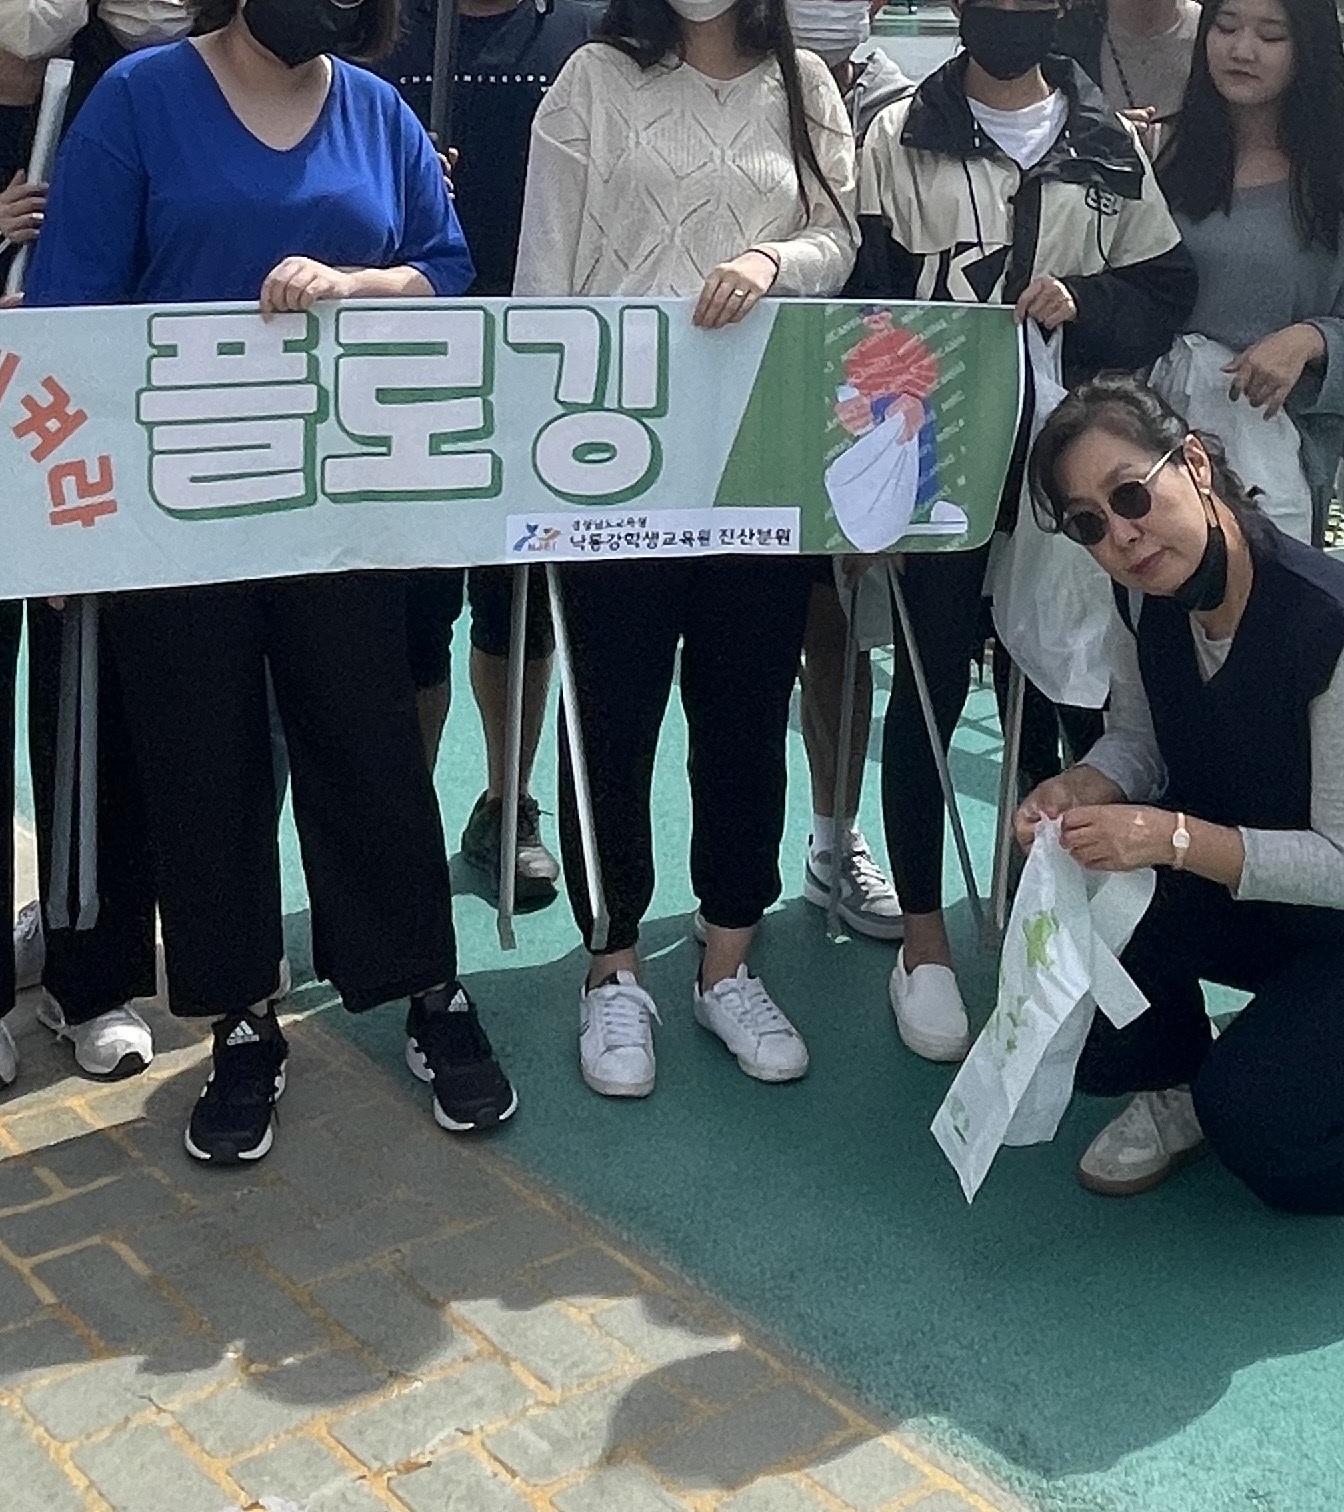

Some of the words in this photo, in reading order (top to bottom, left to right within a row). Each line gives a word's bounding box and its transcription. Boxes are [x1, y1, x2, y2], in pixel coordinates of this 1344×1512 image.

[136, 304, 670, 521] 플로깅
[569, 529, 712, 552] 낙동강학생교육원
[718, 528, 792, 547] 진산분원
